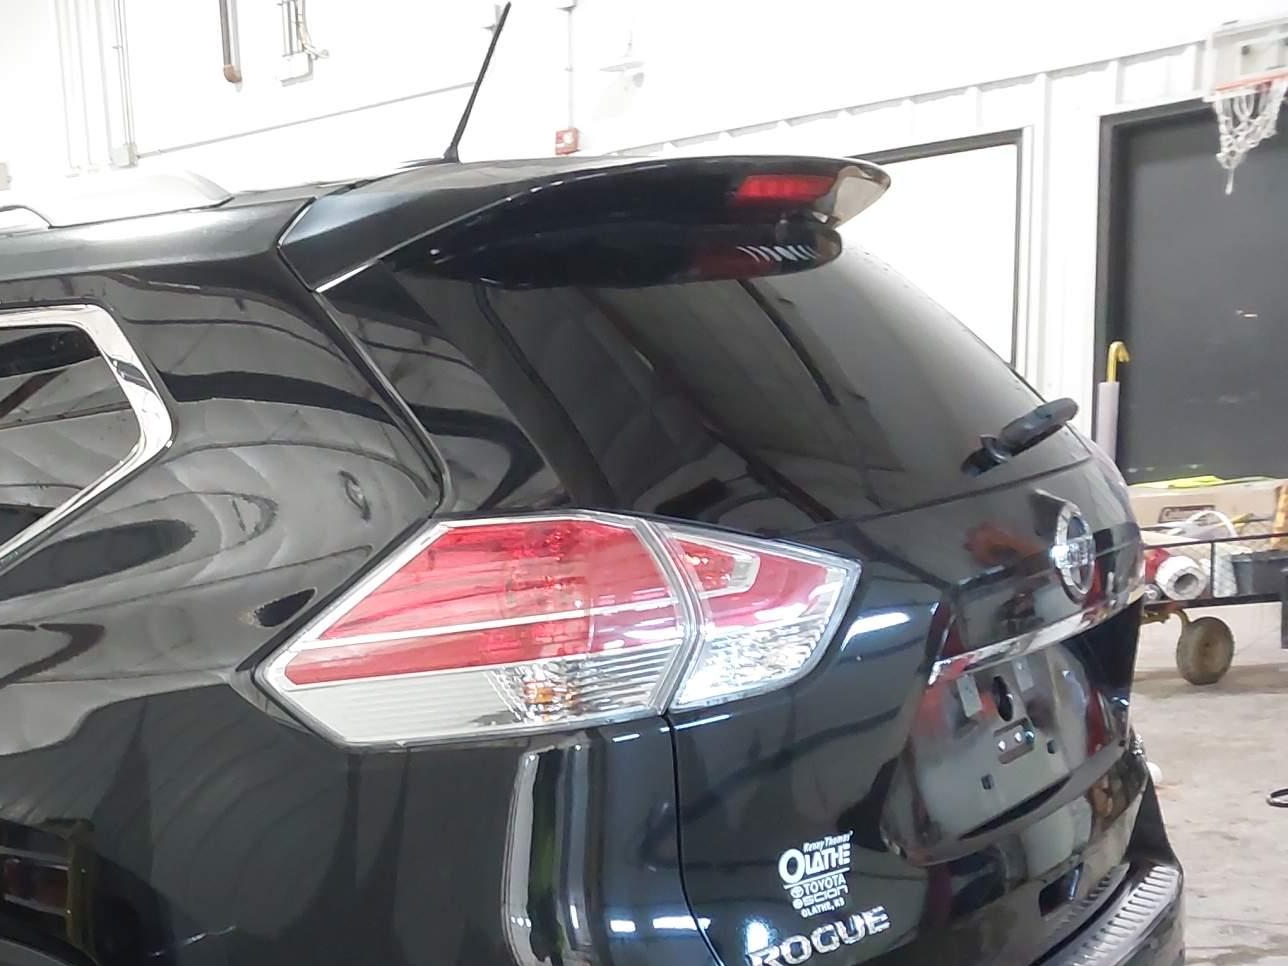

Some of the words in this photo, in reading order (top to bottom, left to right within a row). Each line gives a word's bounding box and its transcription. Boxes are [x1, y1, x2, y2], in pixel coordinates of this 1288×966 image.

[778, 843, 851, 884] OLATHE
[803, 874, 847, 895] TOYOTA
[800, 900, 835, 918] OLATHE,
